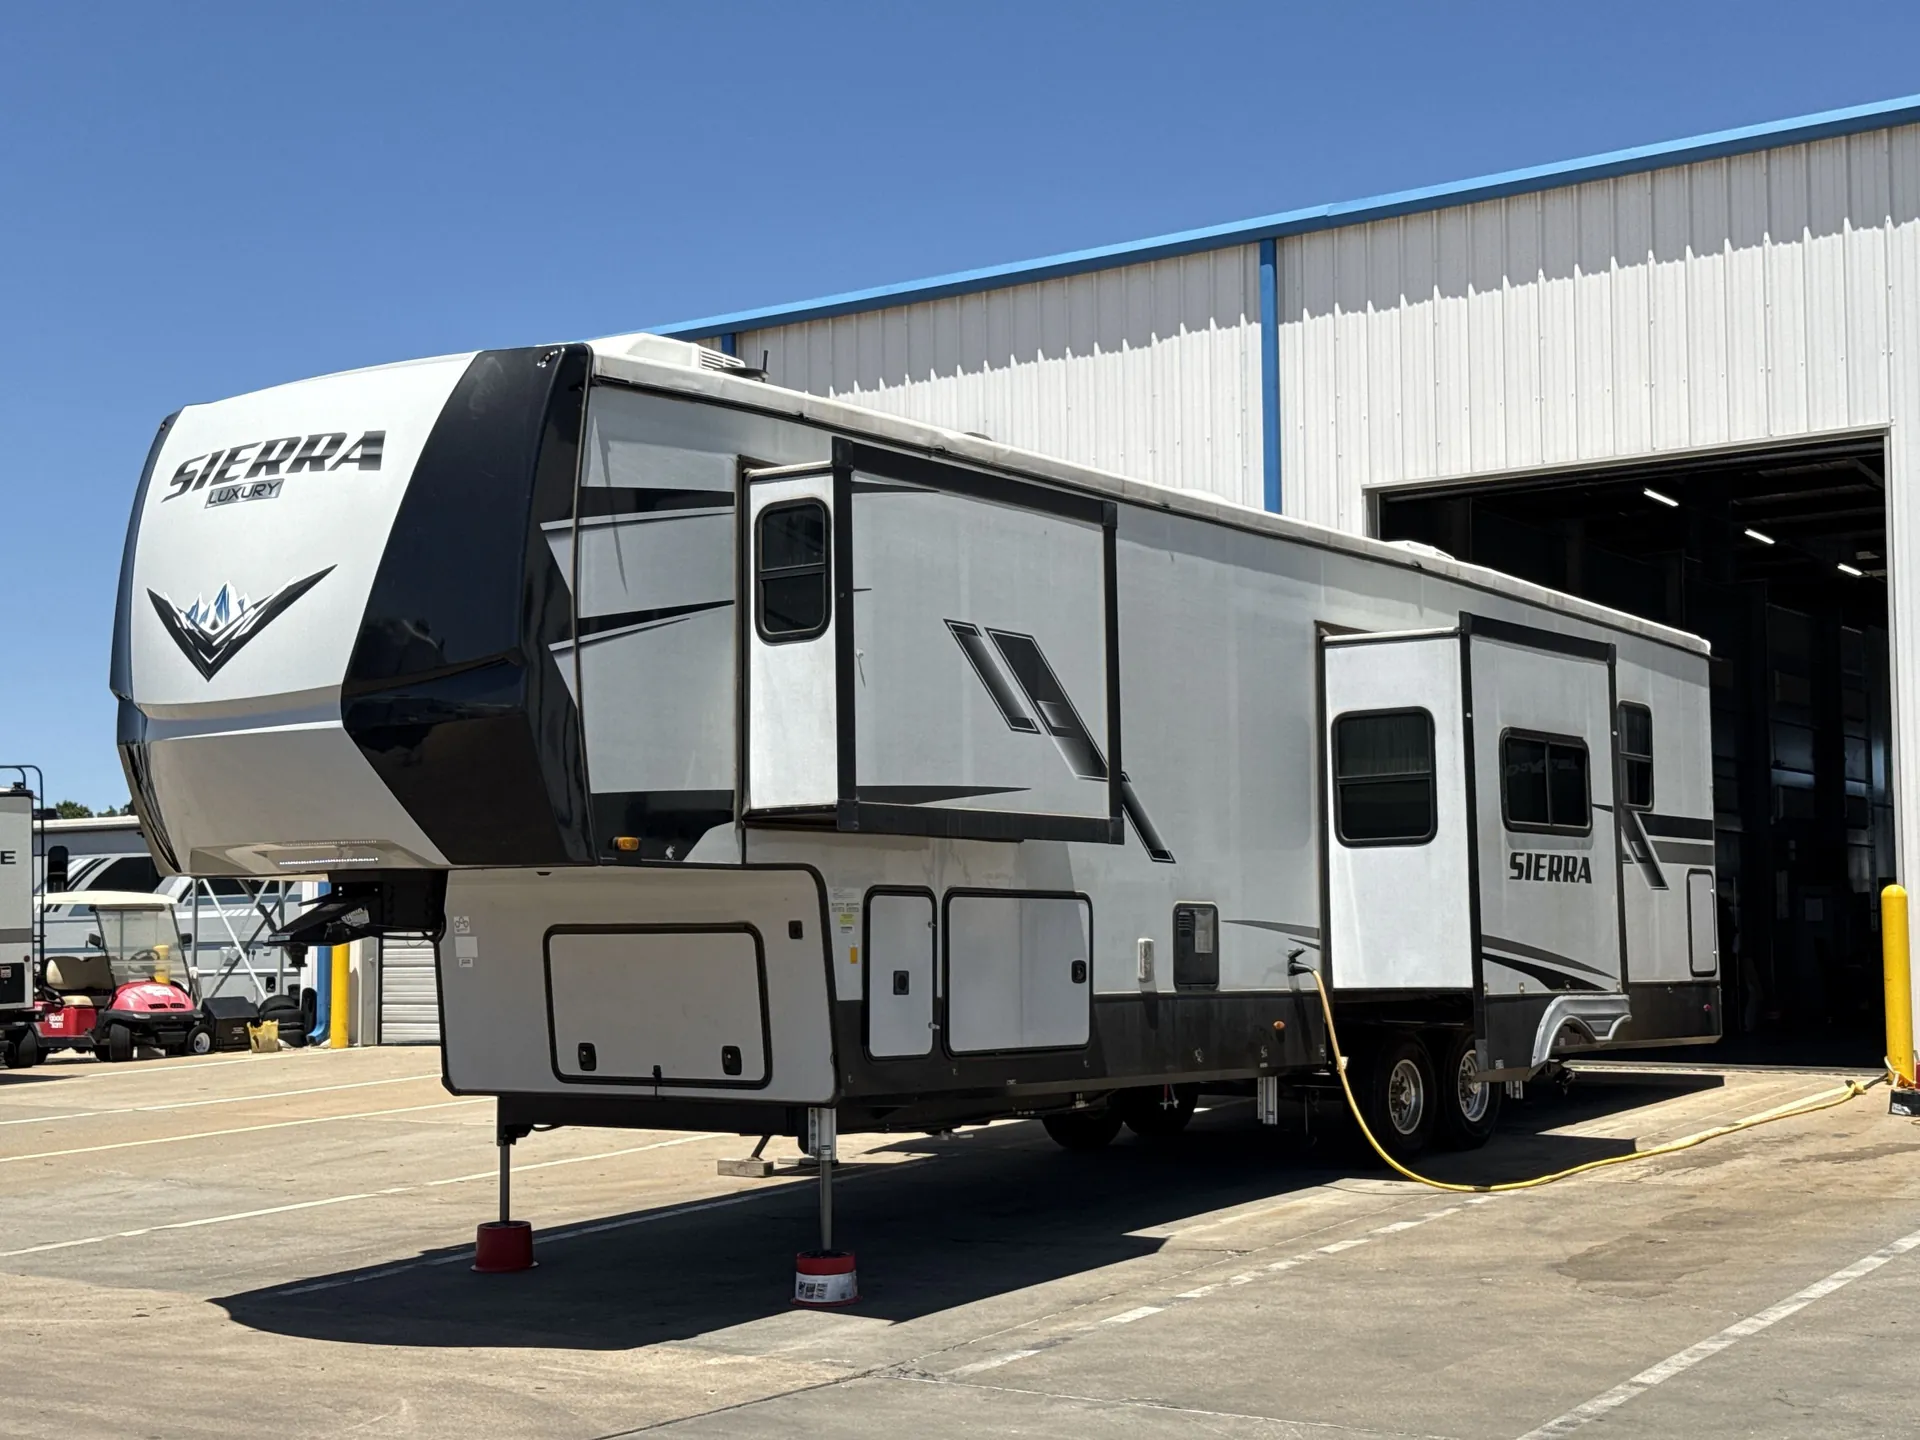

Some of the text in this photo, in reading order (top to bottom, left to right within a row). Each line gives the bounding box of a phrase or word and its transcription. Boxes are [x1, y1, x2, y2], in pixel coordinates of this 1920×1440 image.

[161, 430, 387, 503] SIERRA
[208, 481, 283, 504] LUXURY
[1509, 852, 1592, 884] SIERRA
